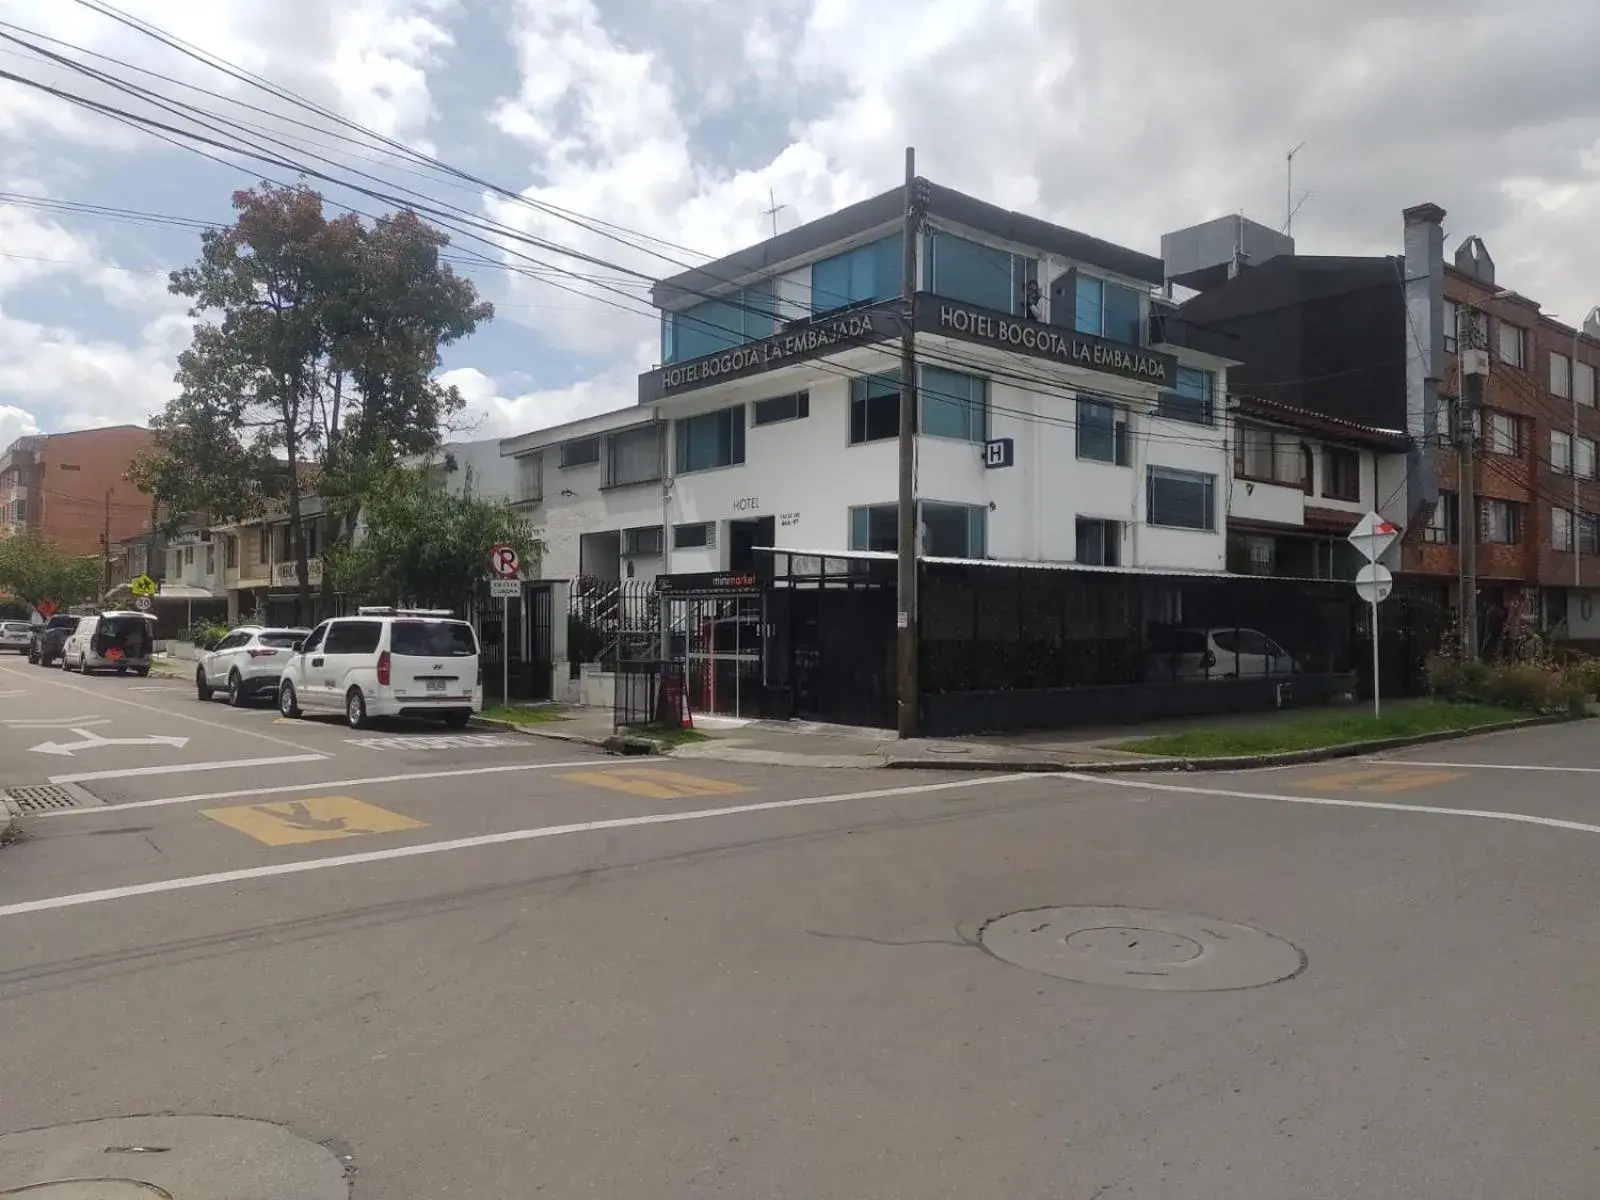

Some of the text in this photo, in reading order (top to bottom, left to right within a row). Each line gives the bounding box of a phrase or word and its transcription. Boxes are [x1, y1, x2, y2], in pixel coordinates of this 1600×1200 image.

[662, 316, 872, 389] HOTEL BOGOTA LA EMBAJADA
[941, 306, 1166, 378] HOTEL BOGOTA LA EMBAJADA
[734, 498, 759, 511] HOTEL
[713, 574, 756, 586] minimarket
